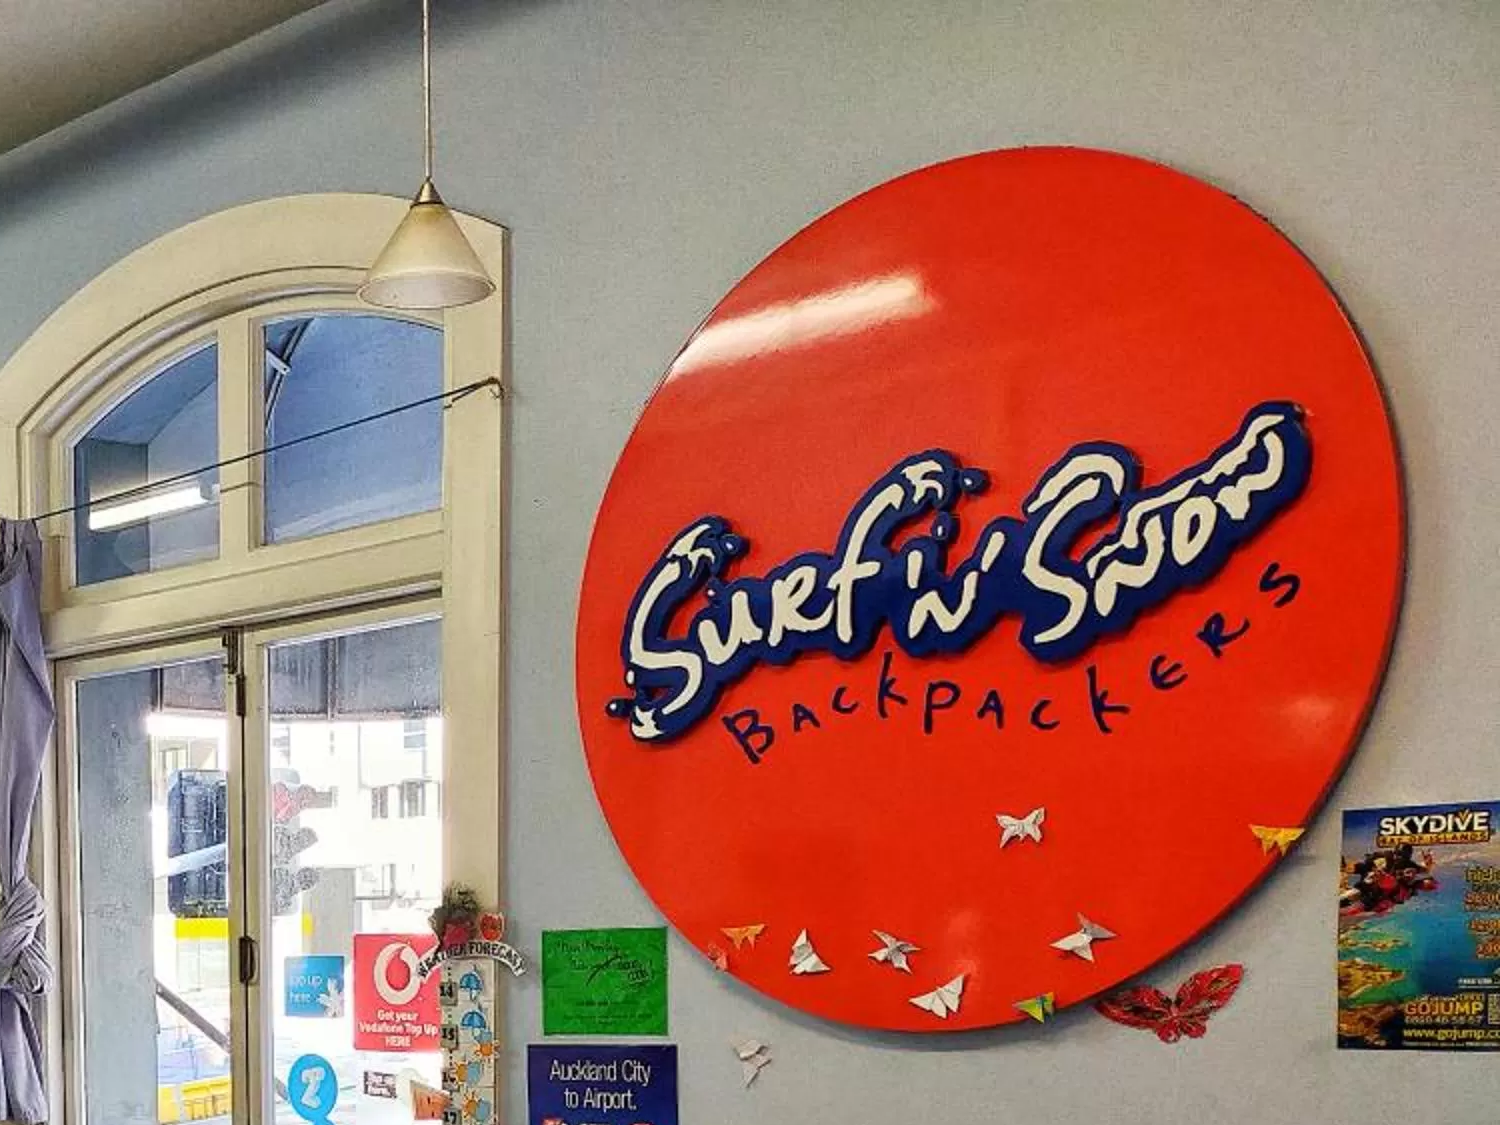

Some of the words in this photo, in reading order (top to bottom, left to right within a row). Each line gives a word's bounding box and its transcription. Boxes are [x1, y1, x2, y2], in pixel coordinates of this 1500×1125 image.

[627, 457, 950, 737] Surf
[1022, 414, 1286, 643] Snow
[1380, 809, 1489, 835] SKYDIVE
[377, 1009, 395, 1021] Get
[395, 1012, 419, 1023] your
[1405, 1000, 1485, 1016] GOJUMP
[359, 1021, 404, 1035] Vodafone
[405, 1022, 423, 1038] Top
[423, 1023, 439, 1038] Up
[384, 1036, 411, 1048] HERE
[550, 1059, 617, 1081] Auckland
[621, 1059, 651, 1087] City
[564, 1087, 579, 1109] to
[583, 1087, 638, 1113] Airport.
